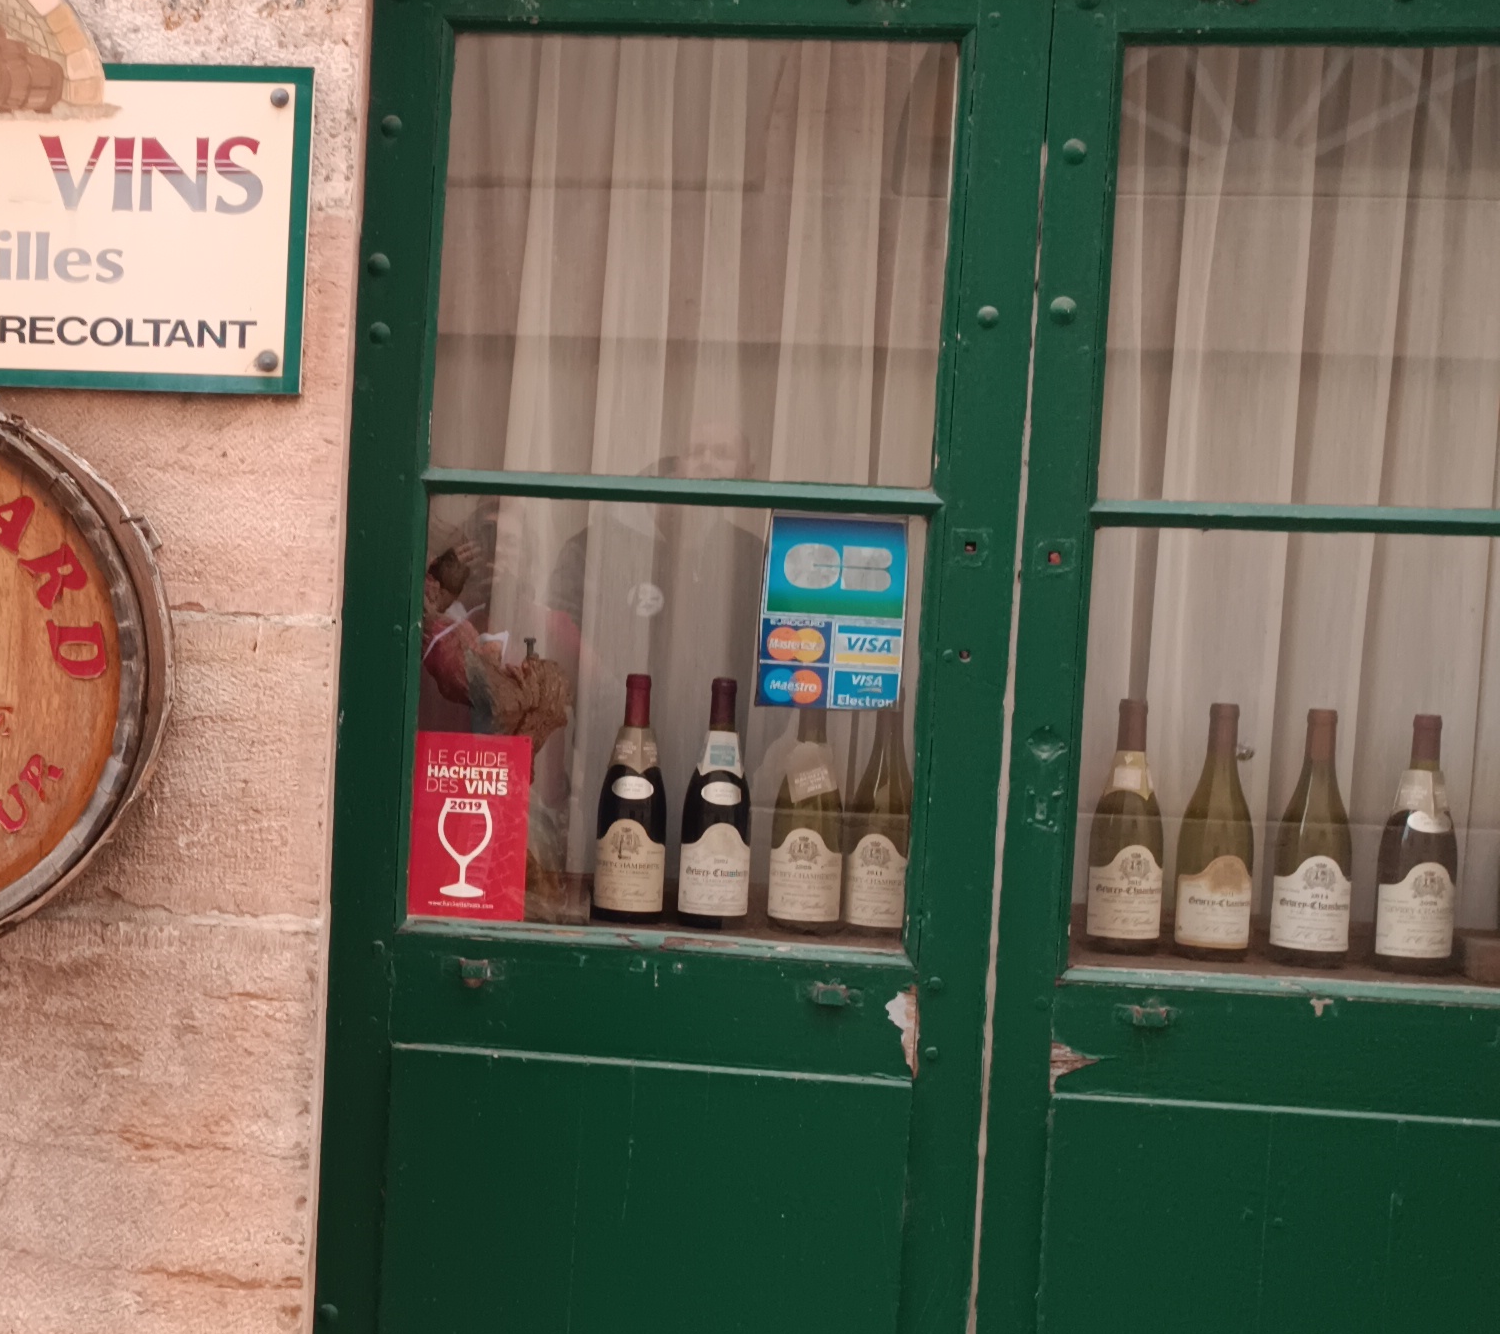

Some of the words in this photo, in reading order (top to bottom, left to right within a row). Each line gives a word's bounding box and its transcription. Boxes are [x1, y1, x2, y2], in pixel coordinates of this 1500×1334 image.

[38, 134, 264, 214] VINS
[783, 543, 893, 592] CB
[846, 637, 893, 654] VISA
[769, 679, 817, 694] Maestro
[851, 674, 883, 687] VISA
[837, 694, 894, 708] Electron
[428, 749, 449, 765] LE
[453, 749, 508, 767] GUIDE
[427, 765, 509, 780] HACHETTE
[426, 778, 459, 794] DES
[464, 779, 508, 796] VINS
[449, 800, 482, 811] 2019
